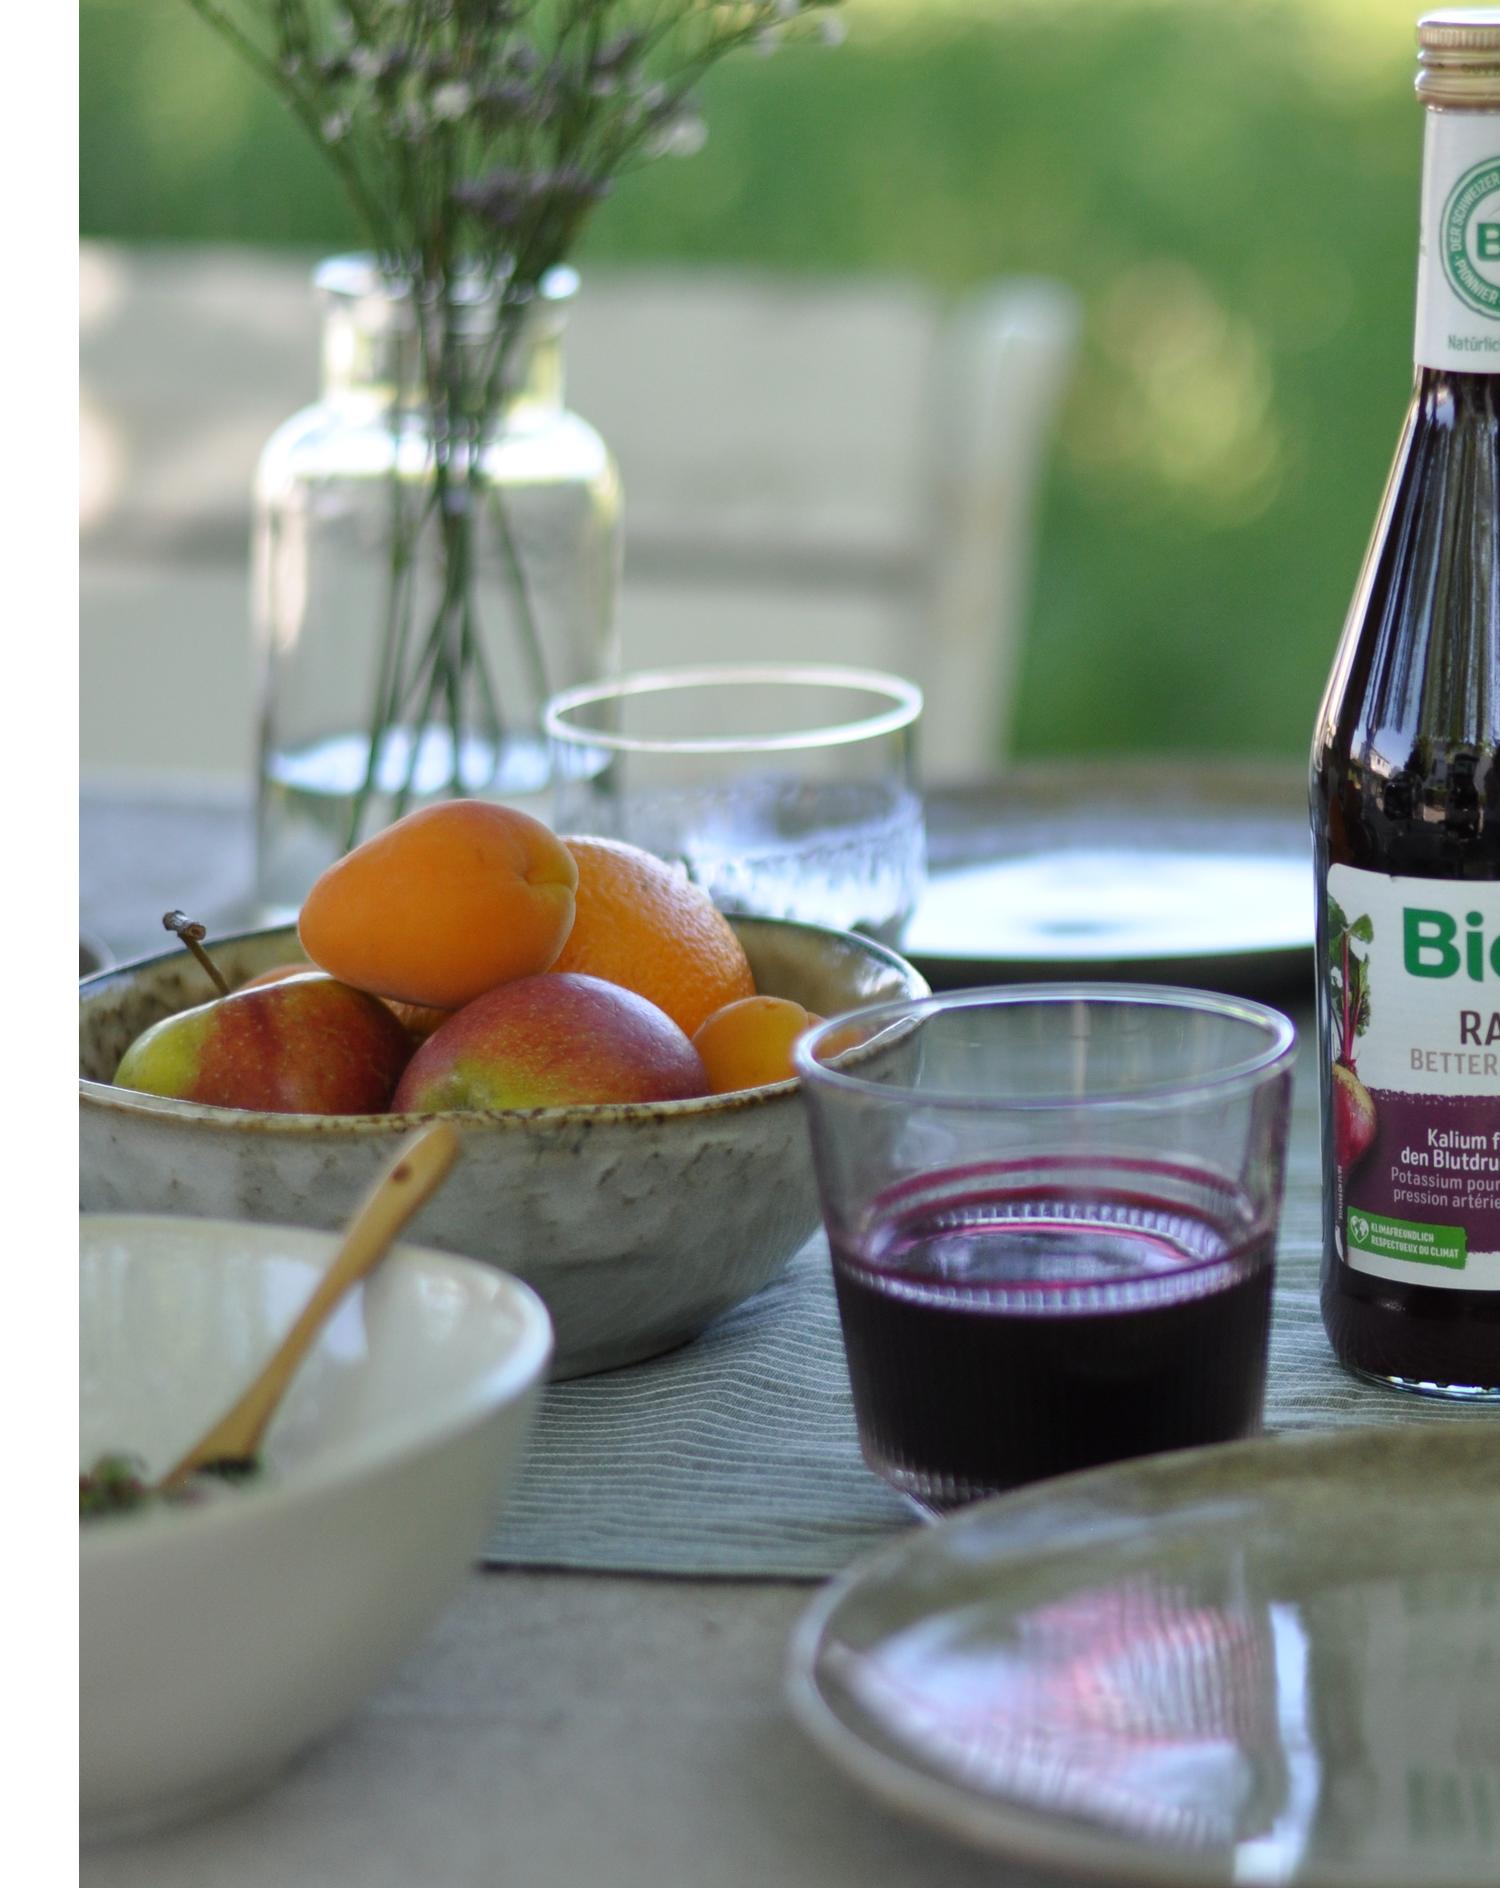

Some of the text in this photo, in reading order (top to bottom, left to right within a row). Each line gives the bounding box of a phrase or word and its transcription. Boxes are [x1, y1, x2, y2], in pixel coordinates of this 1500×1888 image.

[1451, 228, 1463, 251] DER
[1455, 259, 1498, 305] PIONNIER
[1428, 1128, 1488, 1150] Kalium
[1401, 1146, 1429, 1167] den
[1391, 1166, 1462, 1190] Potassium
[1393, 1188, 1449, 1208] pression
[1371, 1222, 1434, 1243] KLIMAFREUNDLICH
[1371, 1235, 1459, 1259] RESPECTUEUX DU CLIMAT
